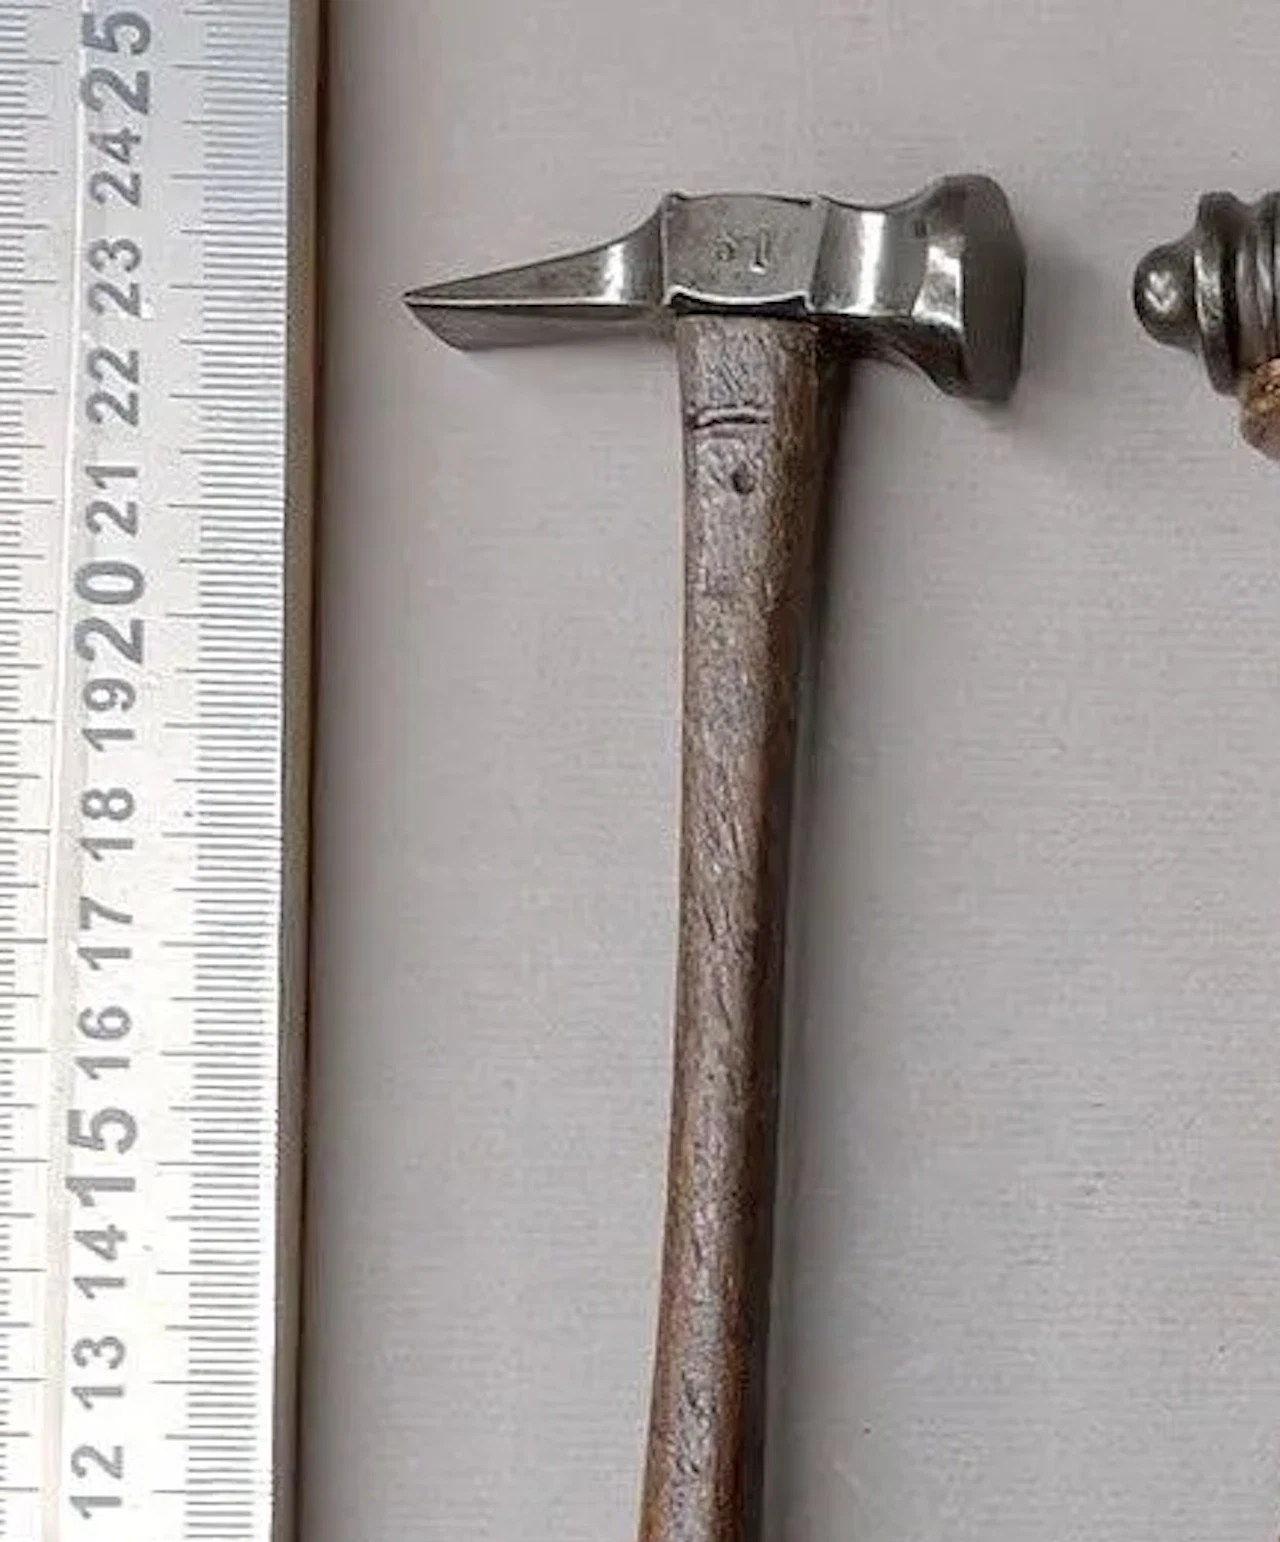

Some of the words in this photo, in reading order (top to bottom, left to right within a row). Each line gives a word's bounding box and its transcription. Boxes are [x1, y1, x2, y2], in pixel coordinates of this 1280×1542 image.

[80, 10, 152, 115] 25
[89, 127, 142, 207] 24
[88, 238, 142, 318] 23
[86, 350, 140, 427] 22
[85, 465, 138, 536] 21
[74, 560, 146, 664] 20
[82, 678, 136, 752] 19
[80, 787, 135, 861] 18
[77, 896, 133, 971] 17
[76, 1006, 132, 1080] 16
[65, 1107, 137, 1207] 15
[73, 1224, 127, 1300] 14
[72, 1336, 125, 1409] 13
[69, 1445, 123, 1519] 12
